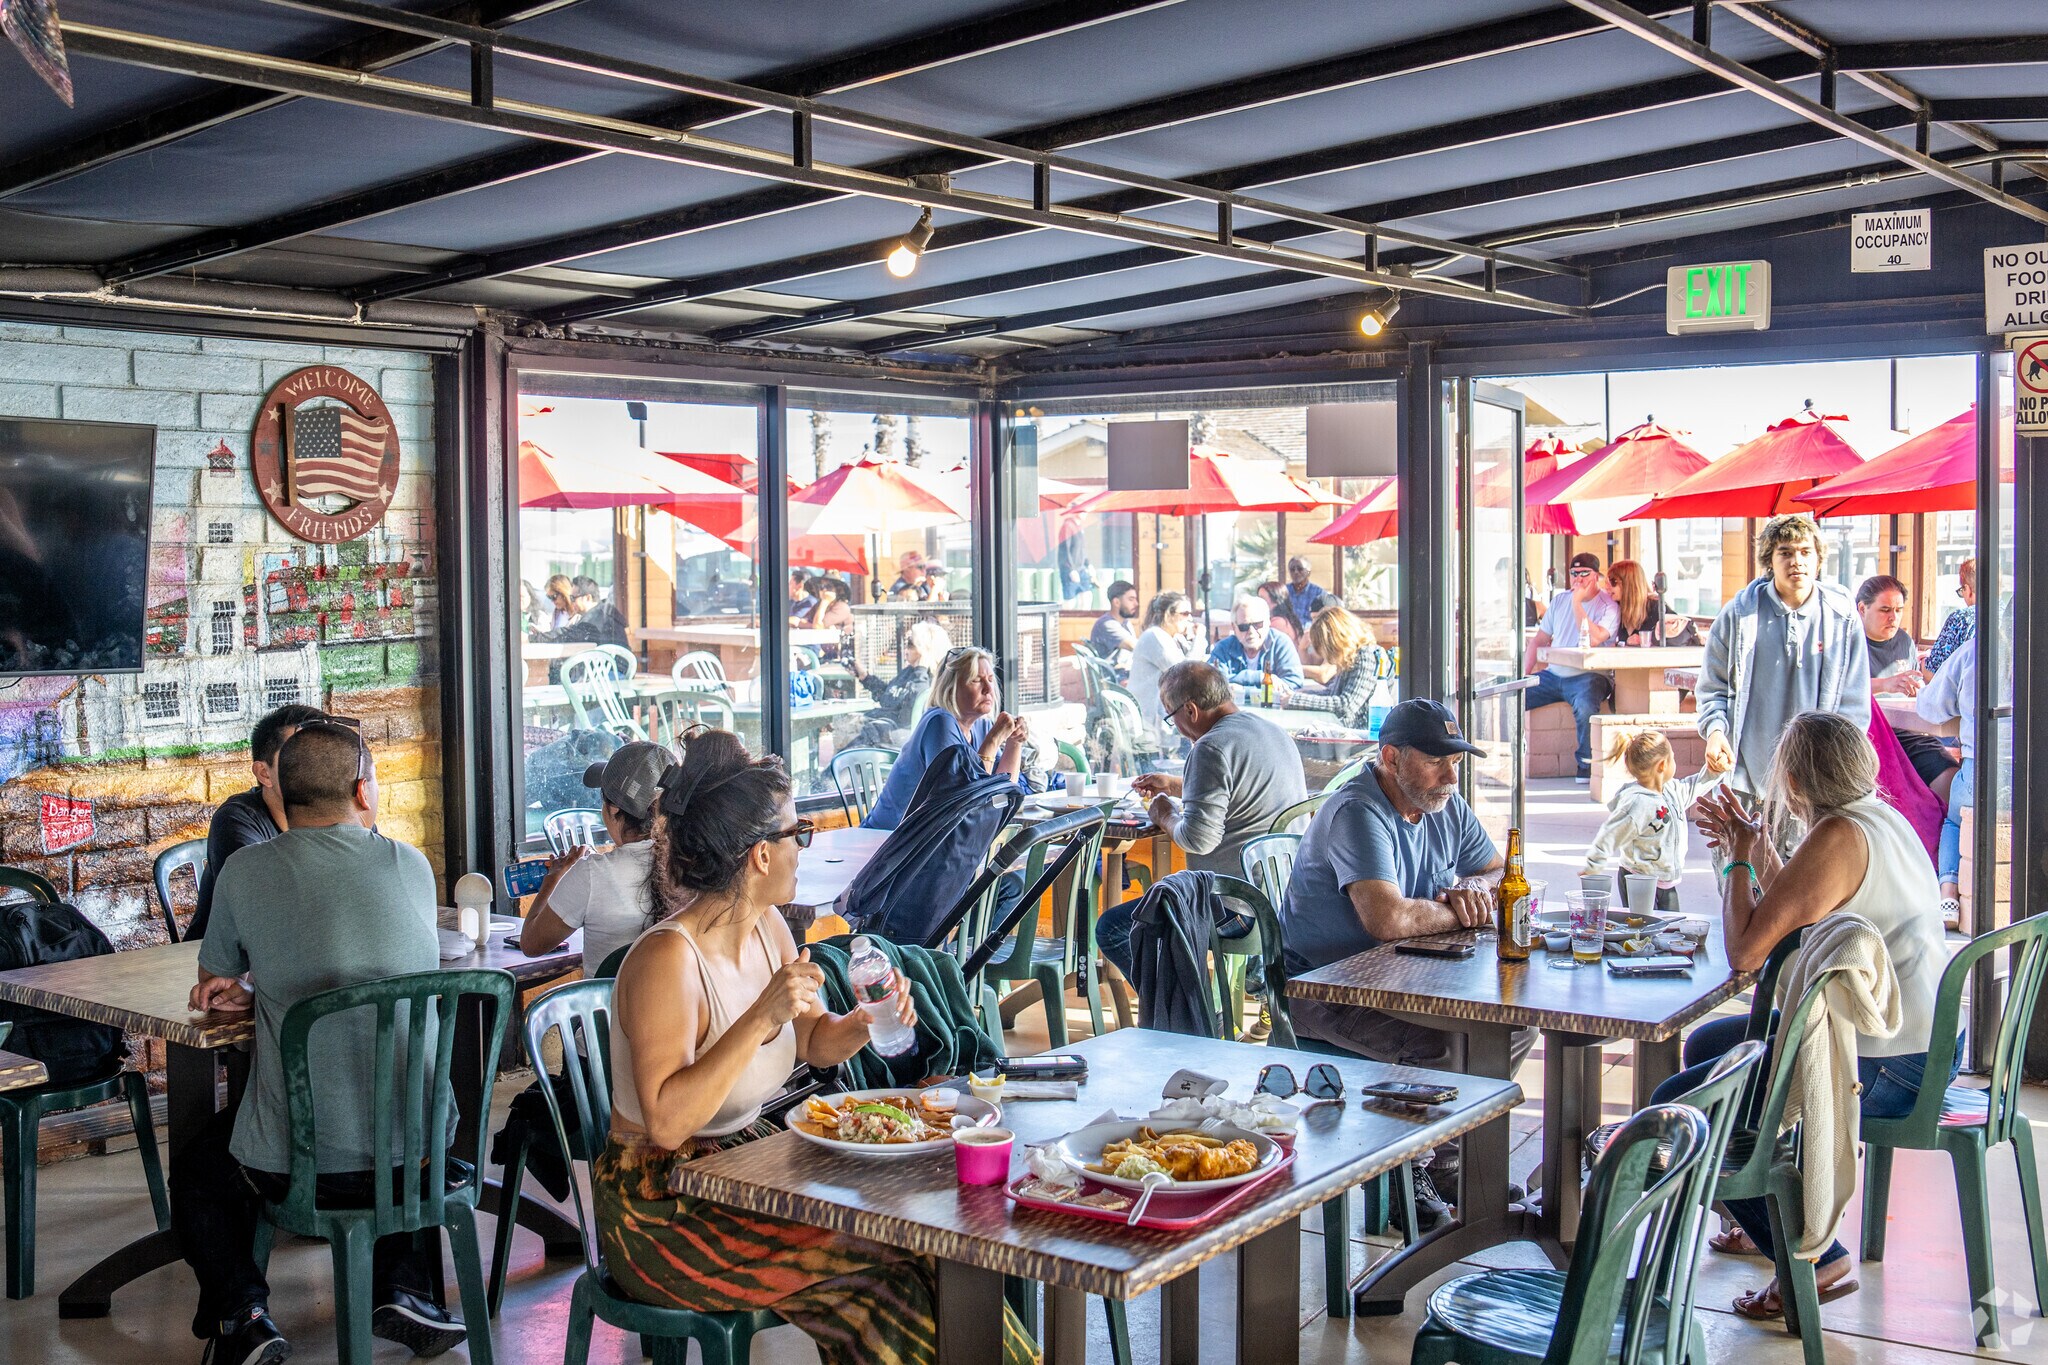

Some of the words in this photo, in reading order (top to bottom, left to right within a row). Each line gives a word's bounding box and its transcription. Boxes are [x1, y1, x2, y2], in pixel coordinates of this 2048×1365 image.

[1865, 215, 1922, 231] MAXIMUM
[1855, 232, 1929, 249] OCCUPANCY
[1887, 254, 1902, 265] 40
[1992, 253, 2019, 268] NO
[2007, 271, 2048, 287] FOO
[1685, 263, 1752, 318] EXIT
[2015, 290, 2048, 306] DRI
[284, 369, 377, 410] WELCOME
[2019, 397, 2037, 410] NO
[2016, 411, 2048, 425] ALLO
[286, 506, 373, 541] FRIENDS
[49, 802, 92, 822] Danger
[51, 827, 71, 840] Stay
